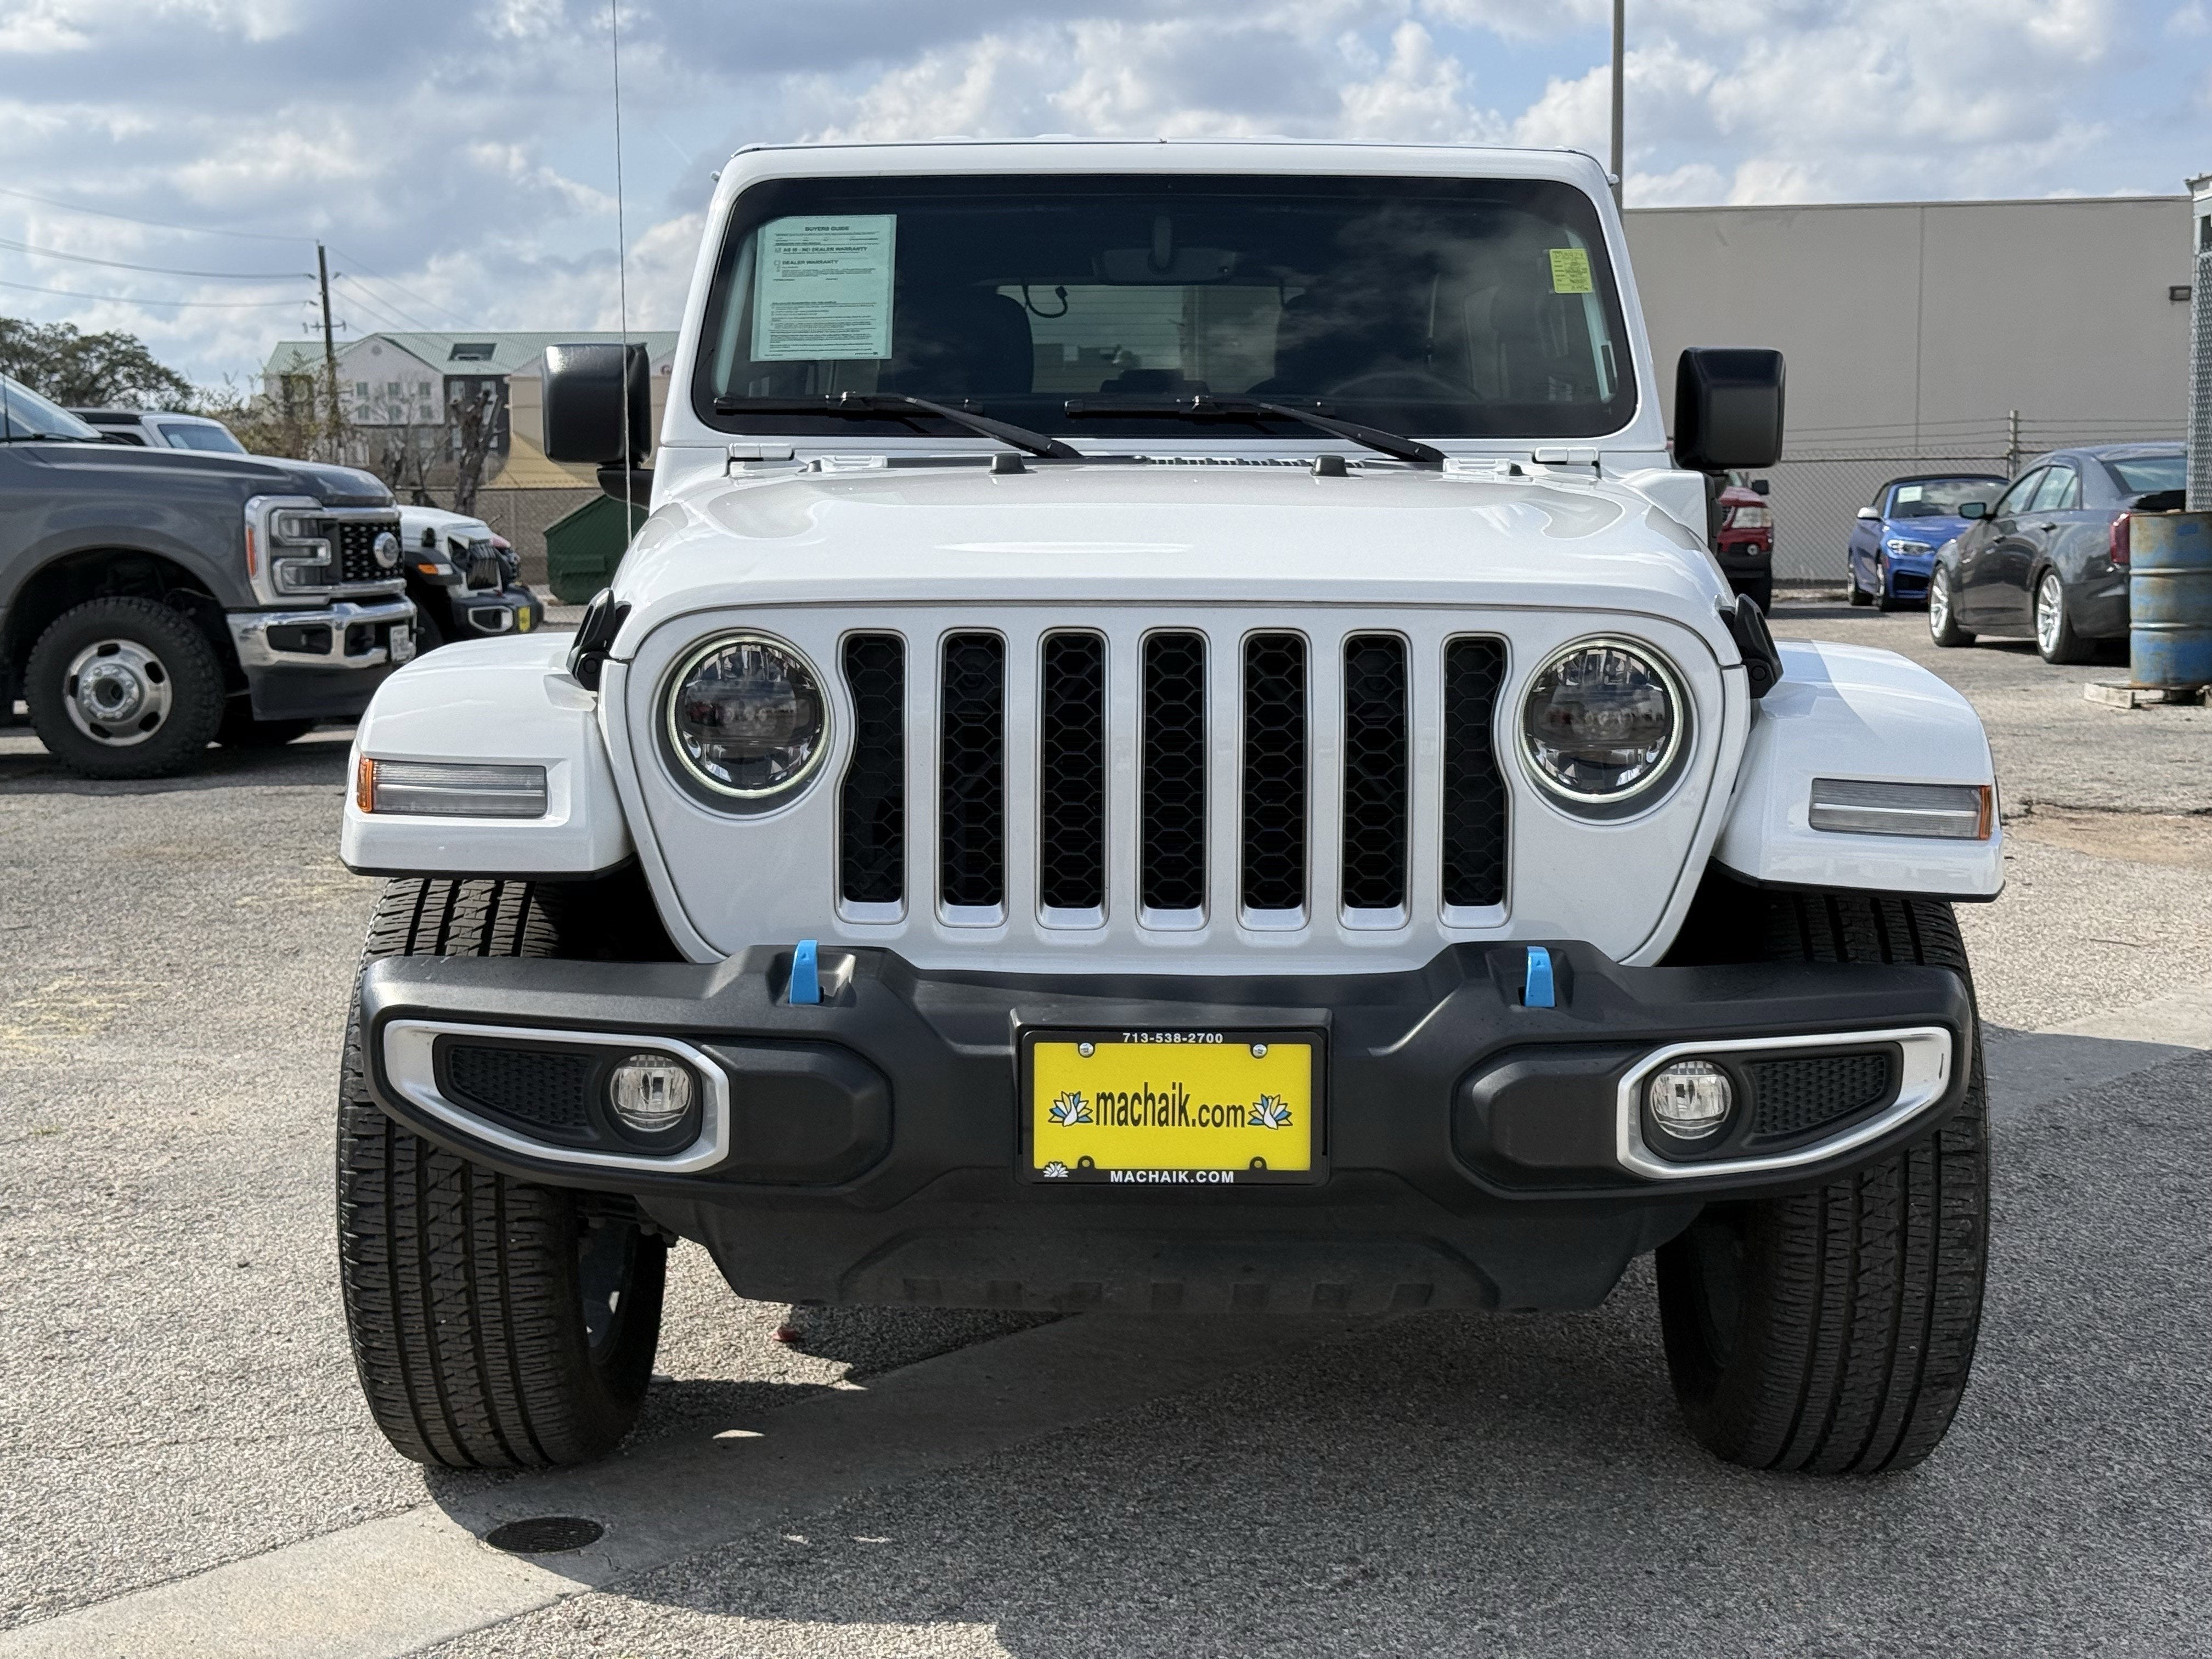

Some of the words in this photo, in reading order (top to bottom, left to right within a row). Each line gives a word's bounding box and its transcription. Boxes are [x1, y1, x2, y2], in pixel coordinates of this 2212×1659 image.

[1122, 1032, 1223, 1043] 713-538-2700
[1096, 1081, 1245, 1128] machaik.com
[1110, 1170, 1234, 1183] MACHAIK.COM
